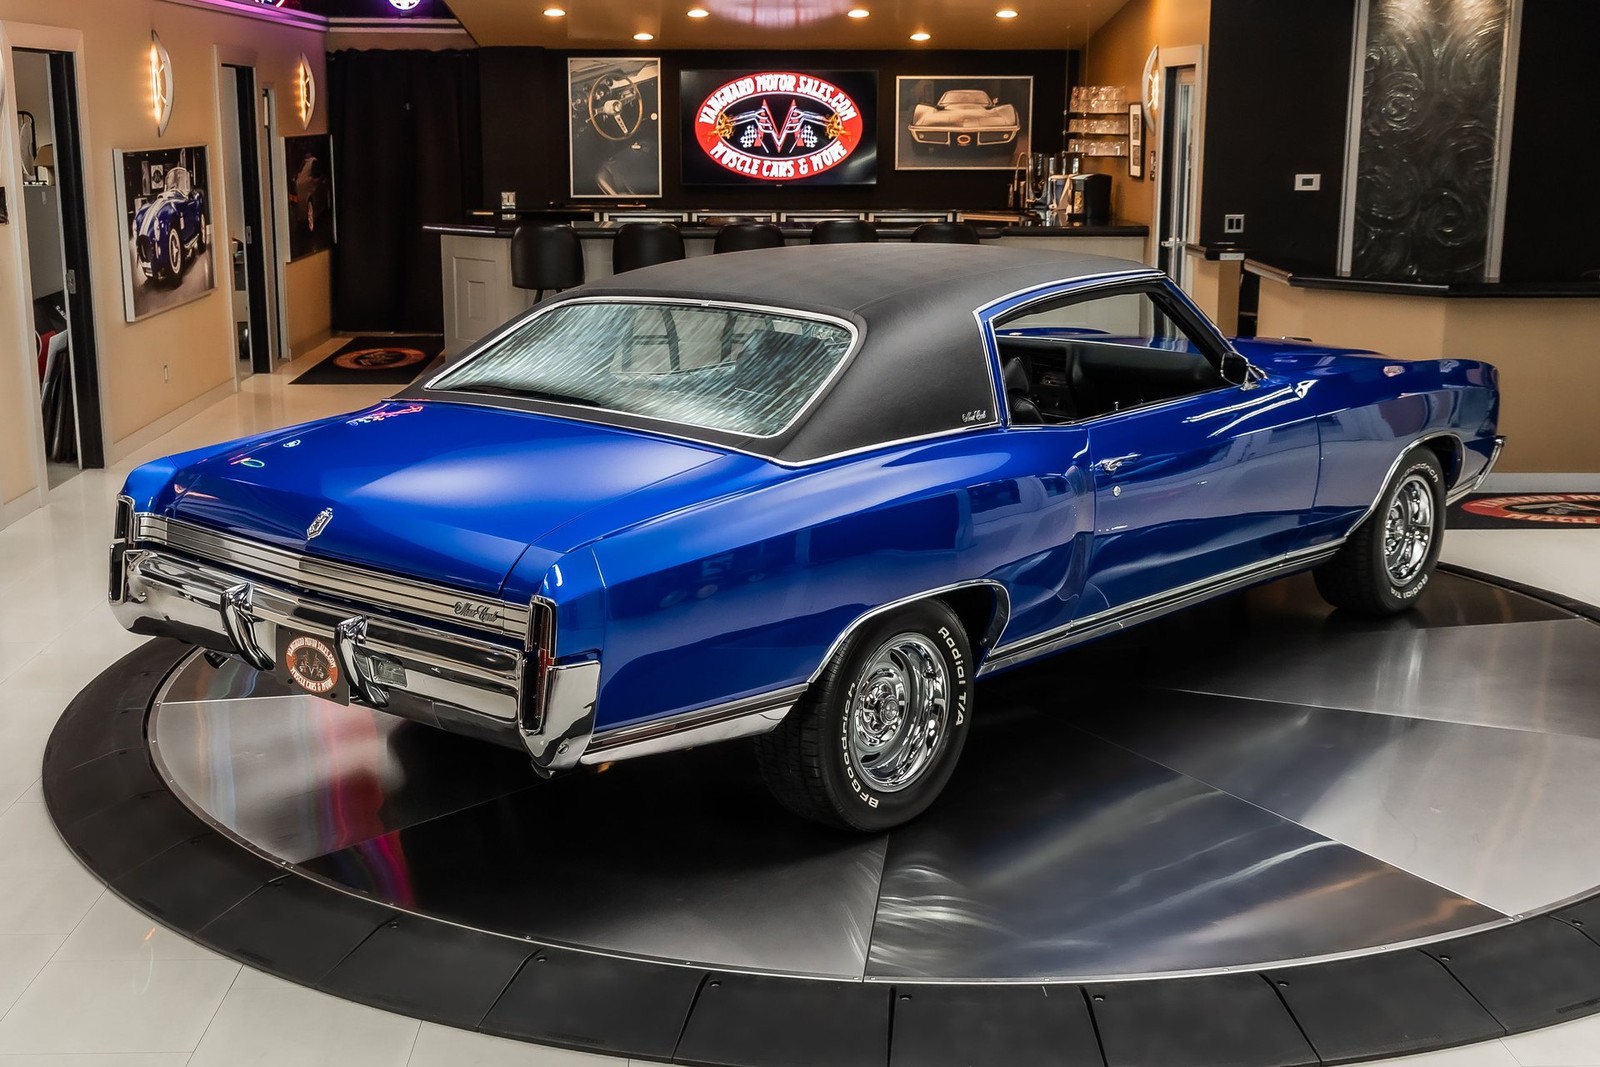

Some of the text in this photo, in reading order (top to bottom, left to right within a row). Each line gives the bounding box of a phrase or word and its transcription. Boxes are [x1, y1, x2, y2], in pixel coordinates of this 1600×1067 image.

[698, 74, 858, 125] VANGUARD MOTOR SALES.COM
[709, 140, 848, 178] MUSCLE CARS & MORE
[290, 667, 306, 687] MUSCLE
[306, 680, 317, 692] CARS
[321, 678, 334, 691] MORE
[938, 626, 967, 727] Radial T/A
